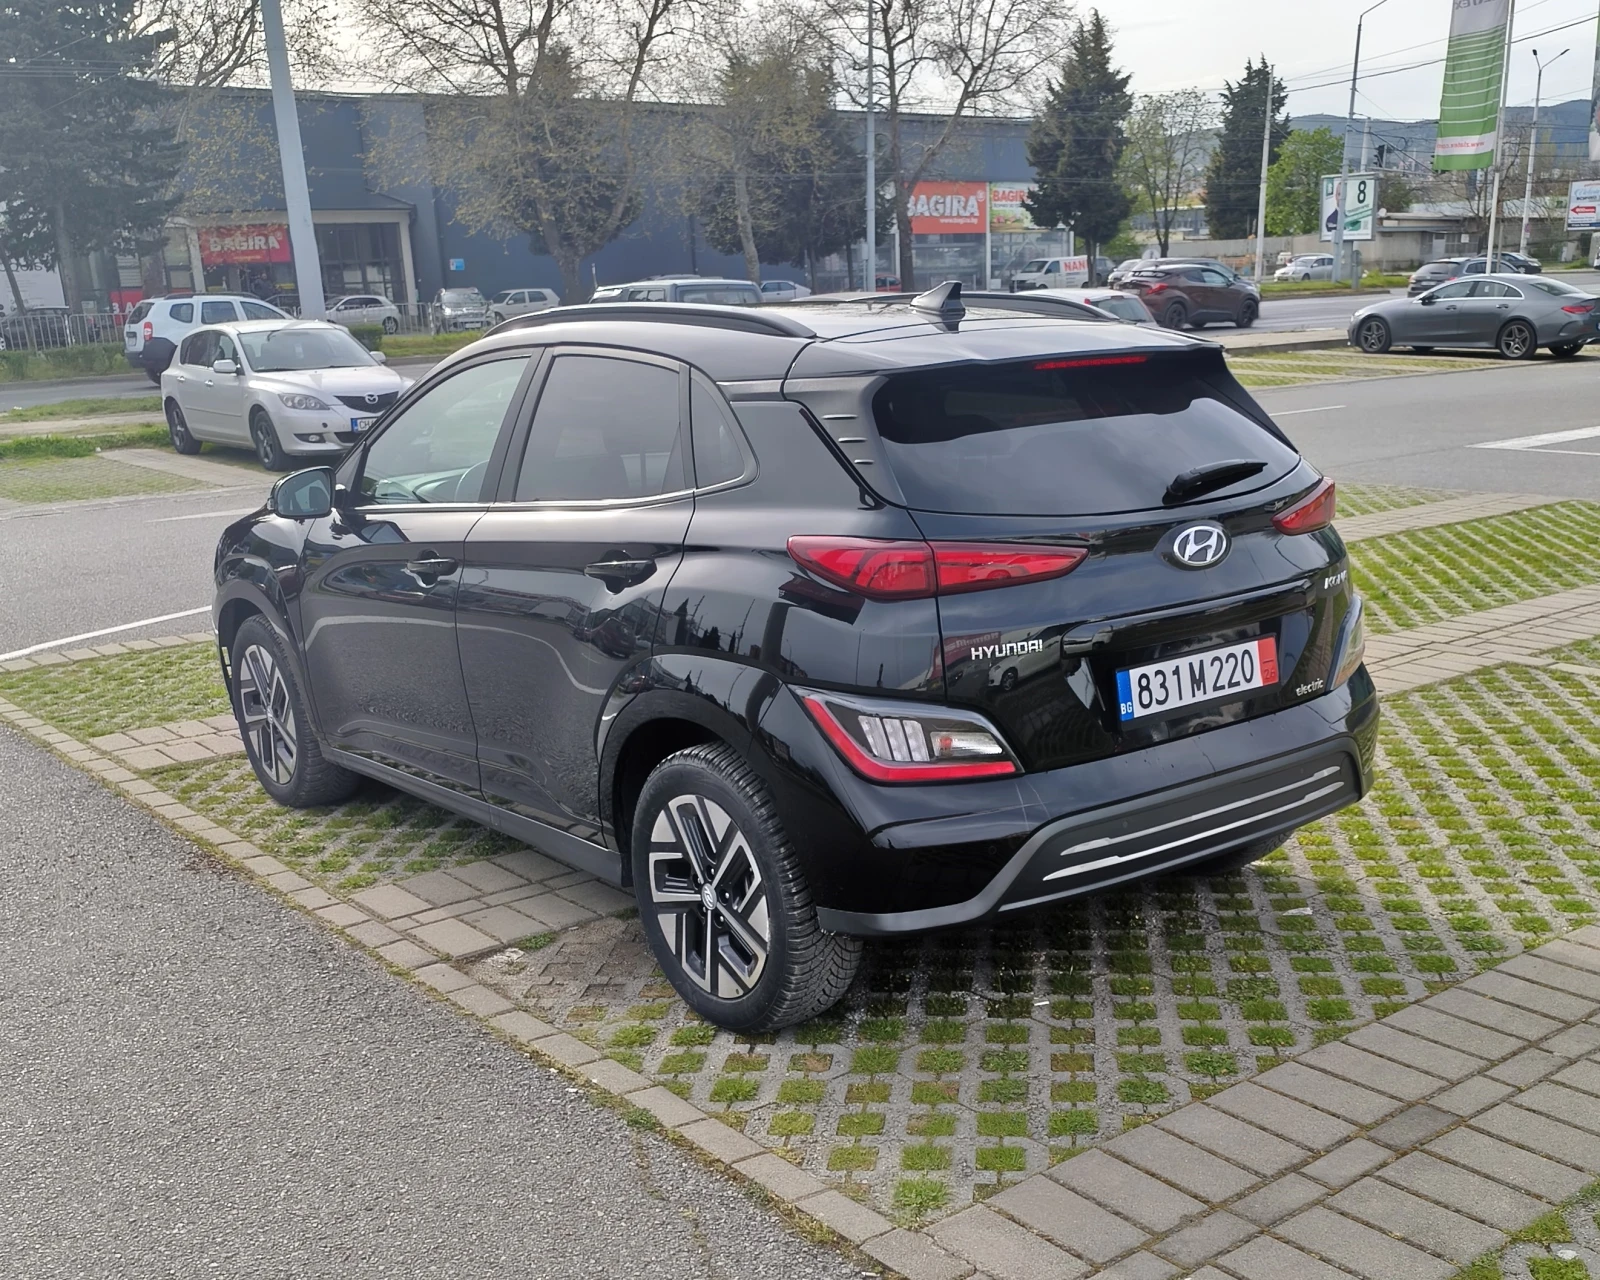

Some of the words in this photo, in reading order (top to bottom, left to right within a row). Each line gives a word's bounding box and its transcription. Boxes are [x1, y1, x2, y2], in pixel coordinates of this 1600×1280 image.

[993, 190, 1028, 202] BAGIR
[1357, 180, 1367, 204] 8
[907, 194, 979, 217] BAGIRA
[971, 639, 1043, 660] HYUNDAI
[1263, 668, 1275, 680] 26
[1295, 678, 1324, 696] electric
[1120, 702, 1133, 715] BG
